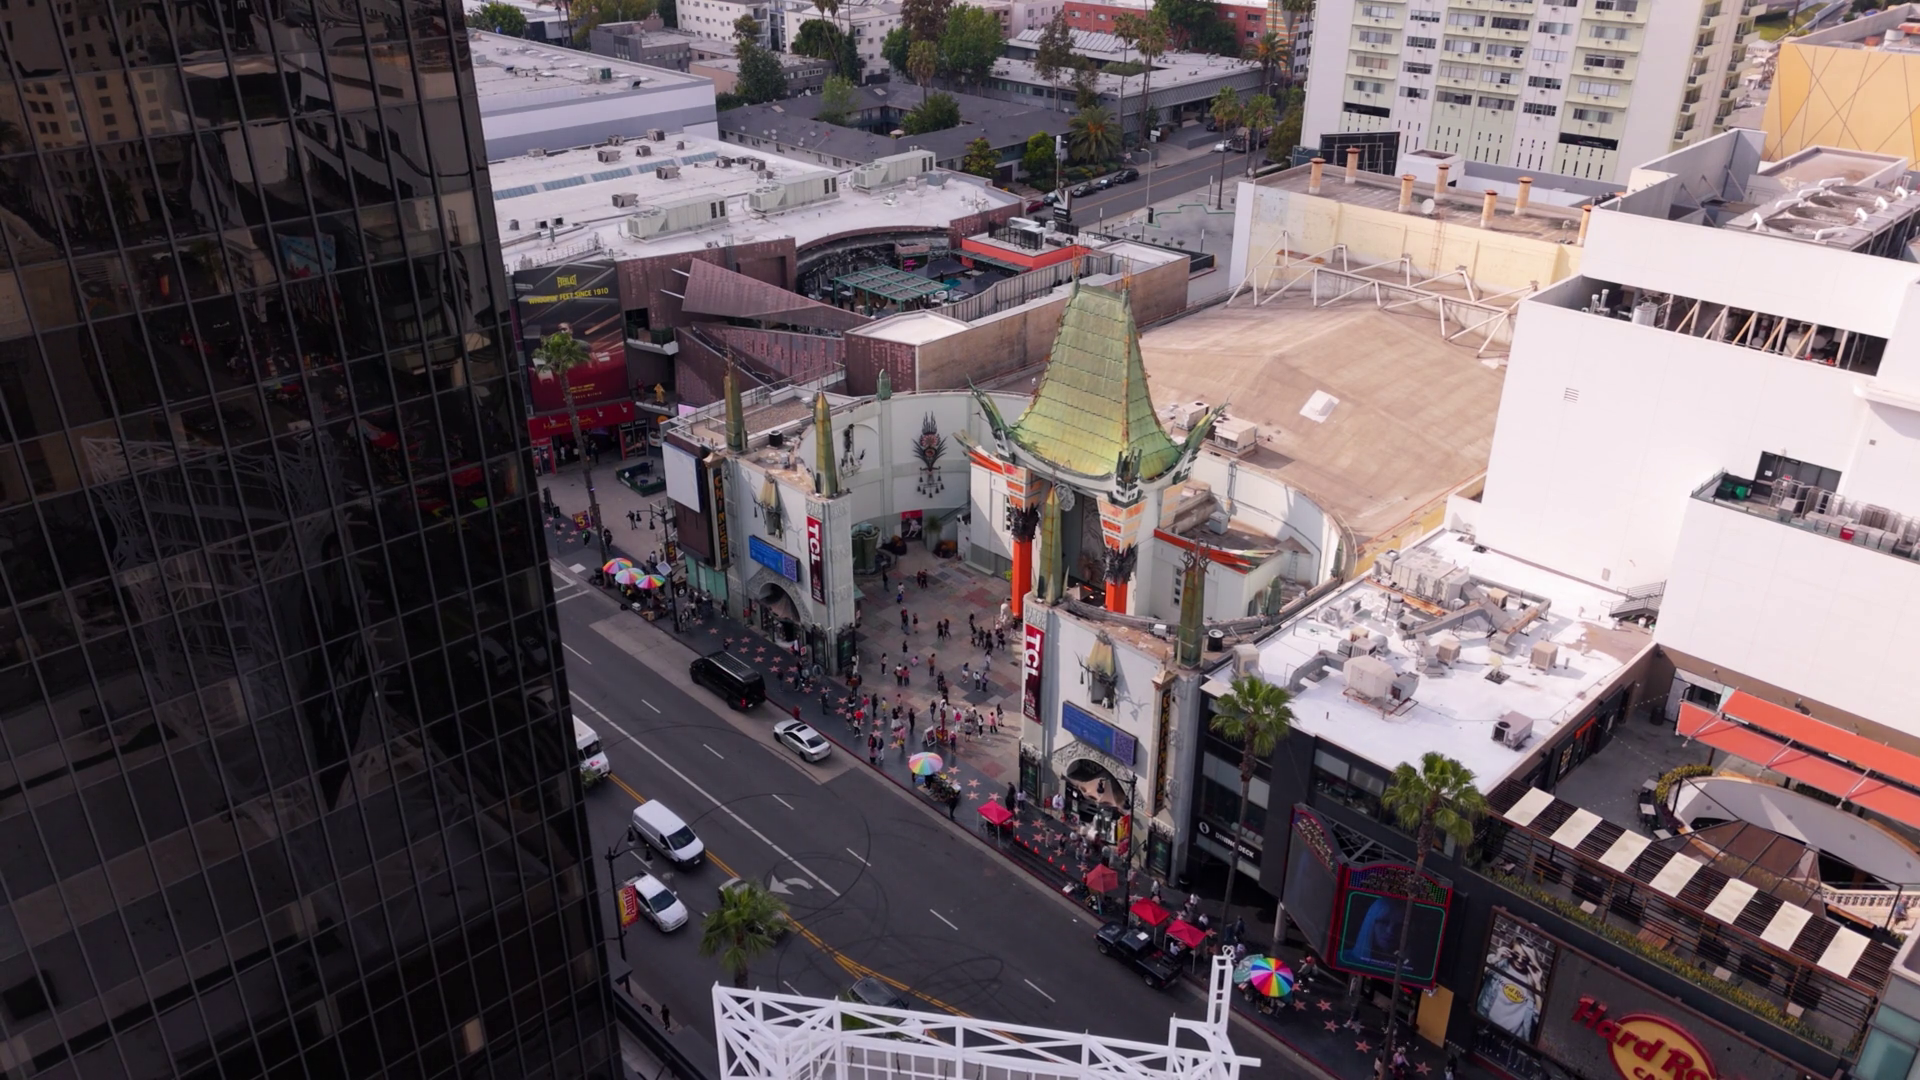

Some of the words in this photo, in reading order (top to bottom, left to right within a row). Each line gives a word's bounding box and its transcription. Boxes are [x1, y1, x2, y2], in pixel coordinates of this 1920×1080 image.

[574, 289, 592, 298] SINCE
[593, 287, 609, 295] 1910
[808, 523, 820, 565] TCL
[1024, 633, 1041, 680] TCL
[1238, 845, 1255, 859] DECK
[1571, 996, 1667, 1063] Hard
